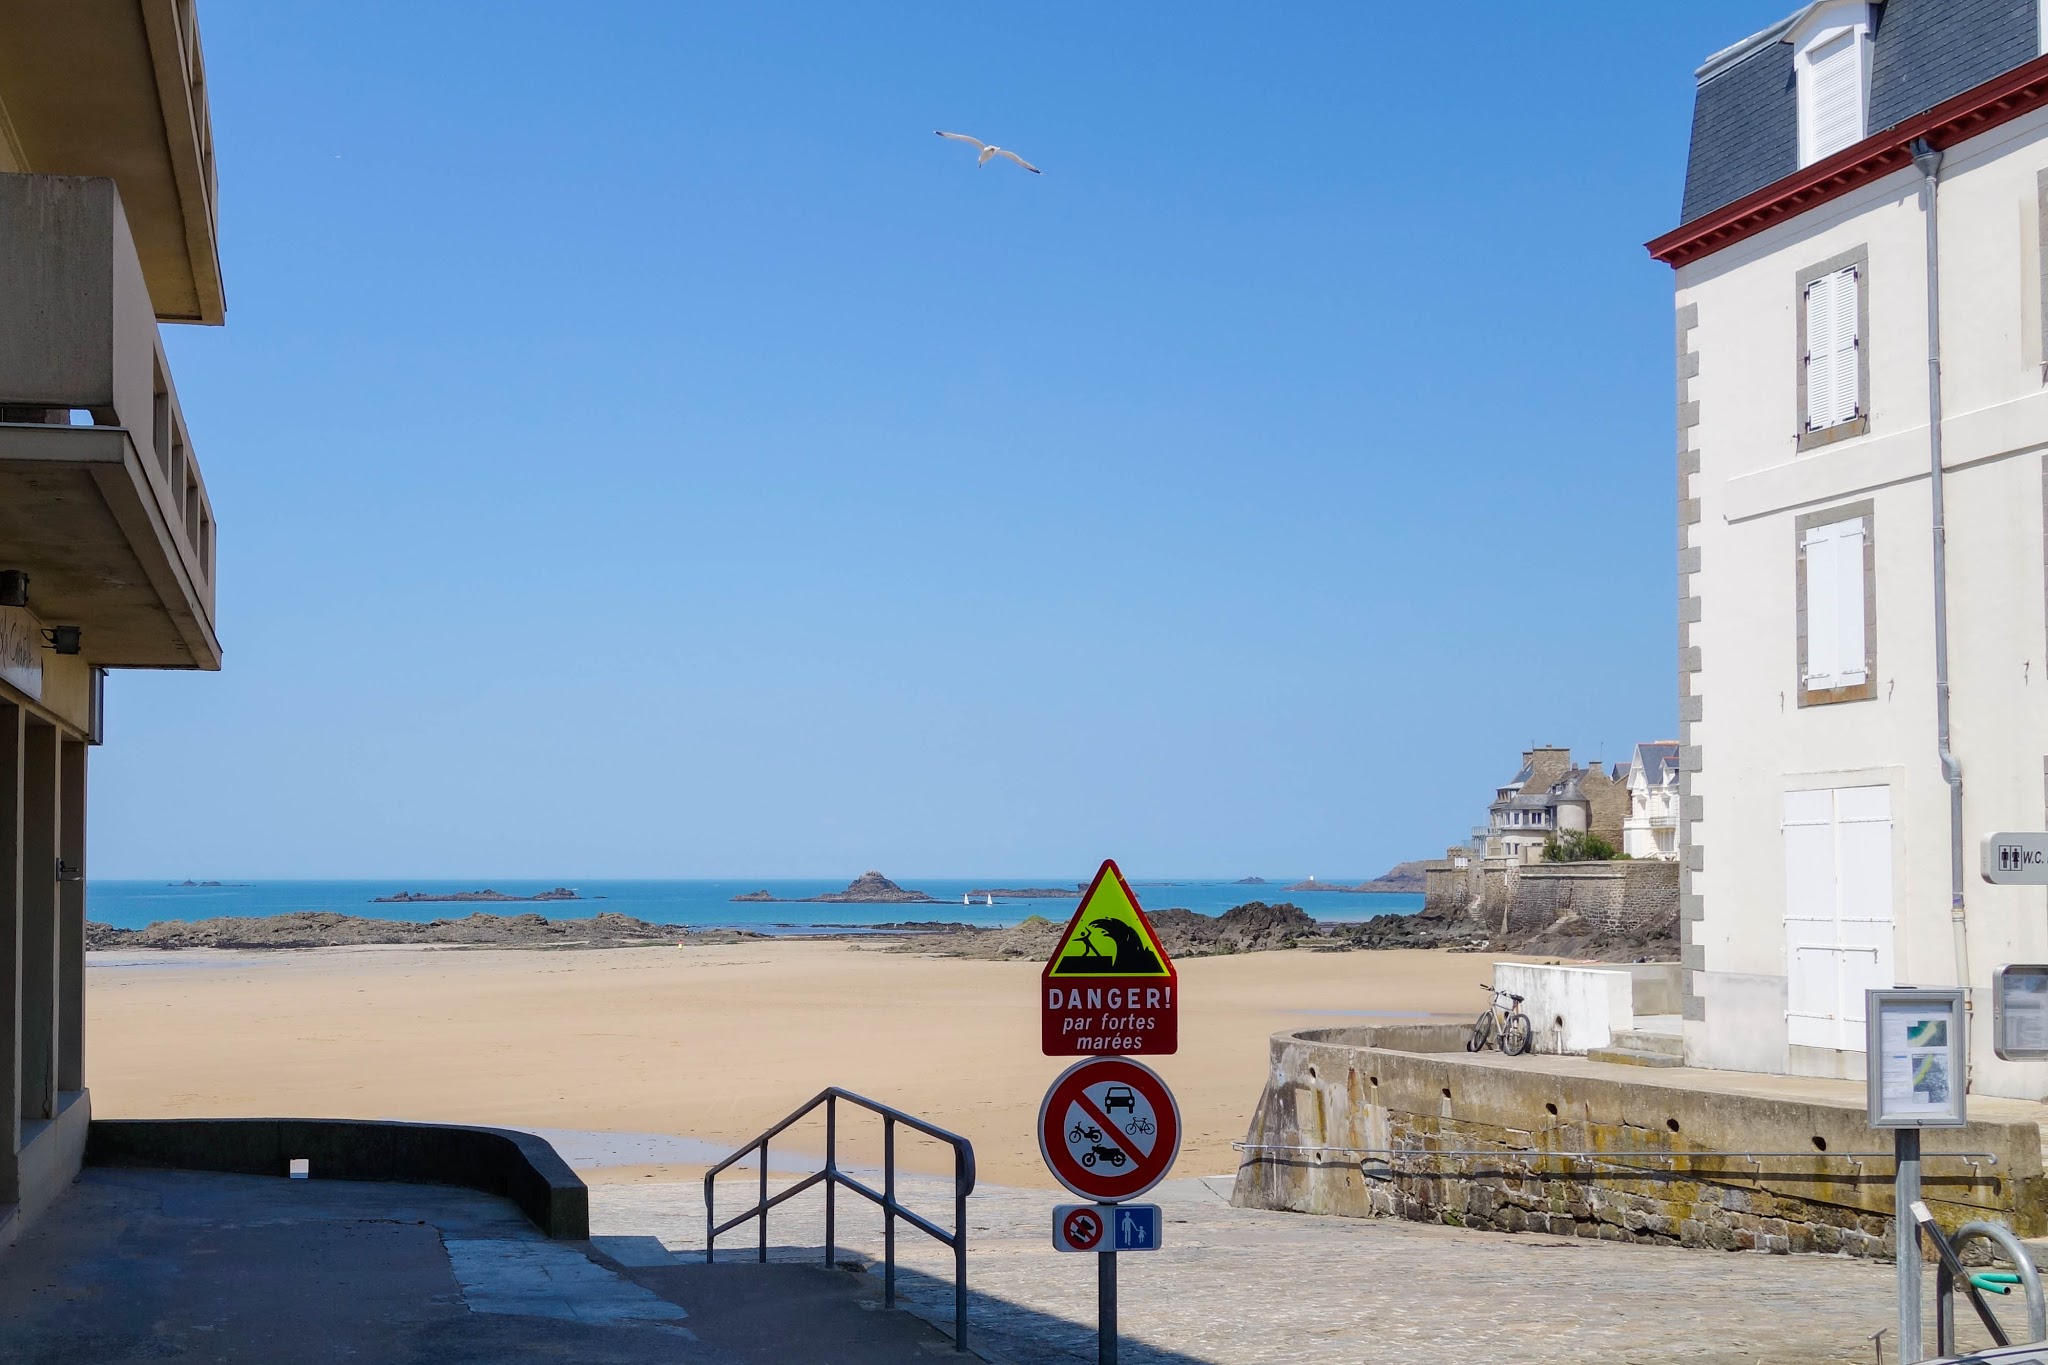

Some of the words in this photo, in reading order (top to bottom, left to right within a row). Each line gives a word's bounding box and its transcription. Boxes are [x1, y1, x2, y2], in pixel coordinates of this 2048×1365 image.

[2023, 851, 2044, 864] W.C.
[1049, 987, 1171, 1010] DANGER!
[1062, 1017, 1092, 1034] par
[1101, 1013, 1155, 1030] fortes
[1076, 1032, 1143, 1050] marées
